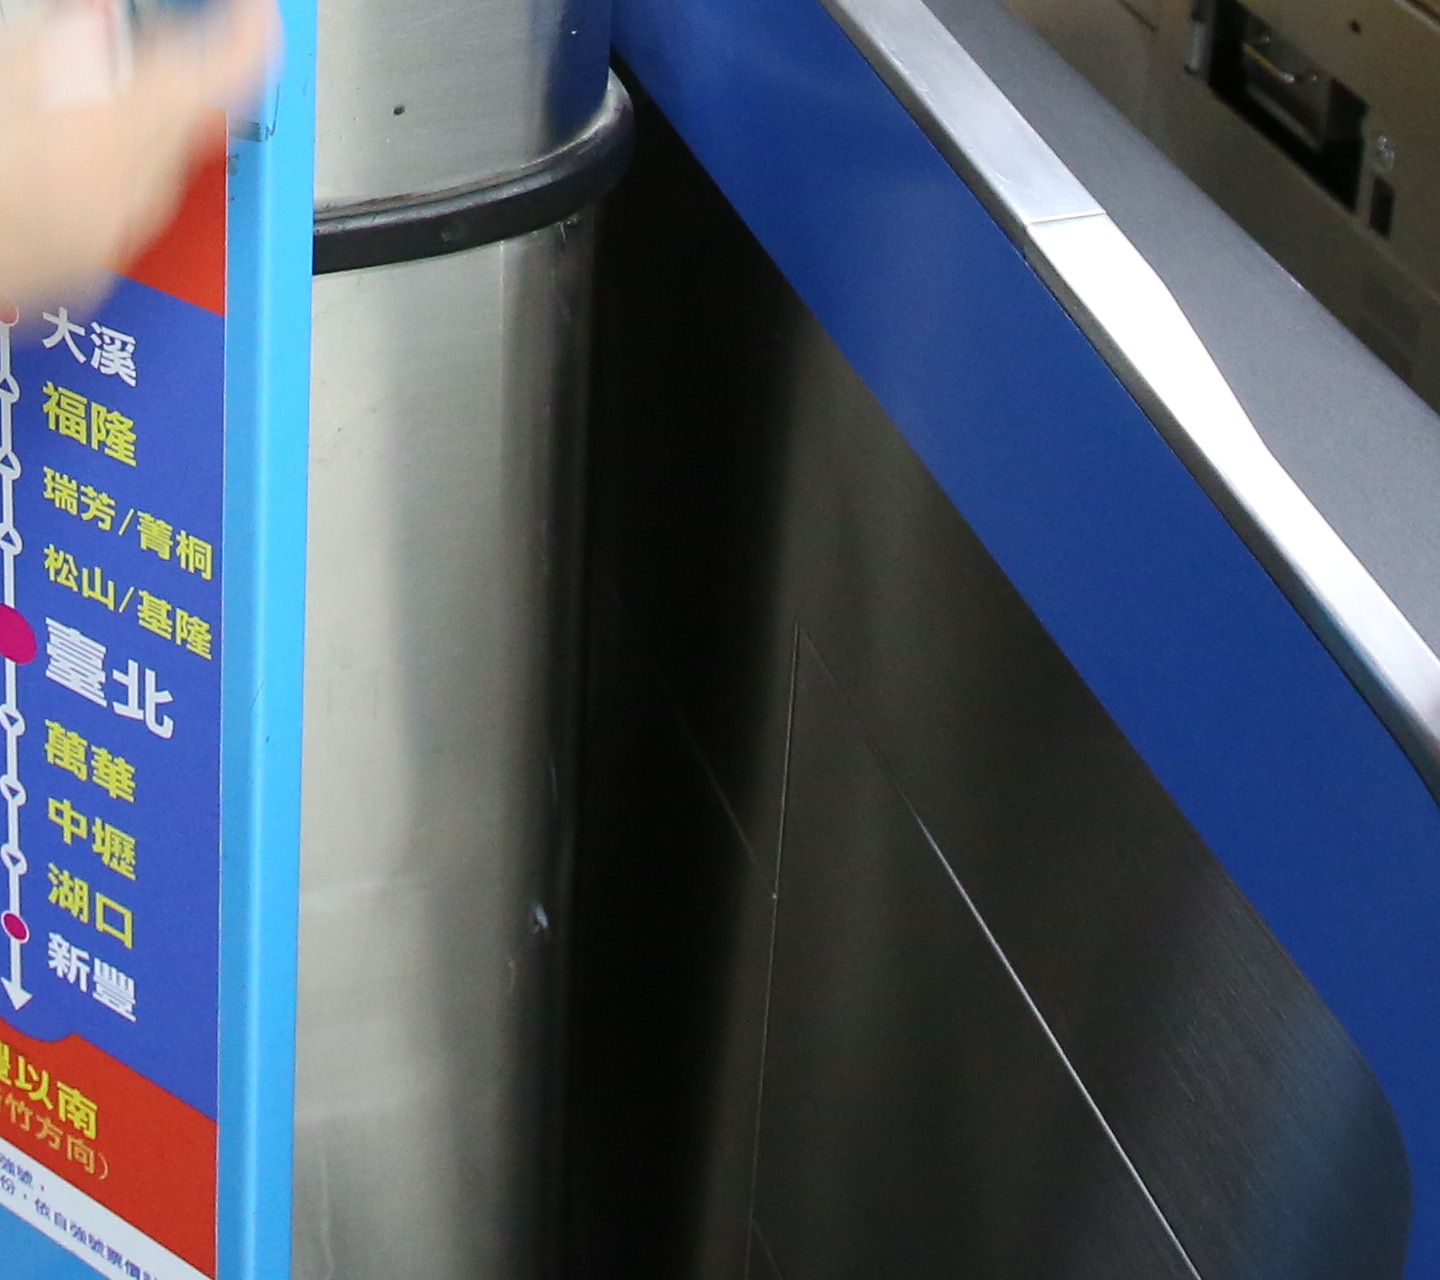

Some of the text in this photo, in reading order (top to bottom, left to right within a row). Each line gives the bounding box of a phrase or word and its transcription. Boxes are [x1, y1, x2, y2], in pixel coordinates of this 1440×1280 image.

[41, 305, 139, 387] 大溪
[41, 380, 139, 468] 福隆
[42, 466, 214, 582] 瑞芳/菁桐
[42, 544, 214, 661] 松山/基隆
[44, 616, 175, 741] 臺北
[43, 718, 138, 804] 萬華
[46, 796, 139, 881] 中壢
[46, 862, 135, 950] 湖口
[46, 931, 138, 1023] 新豐
